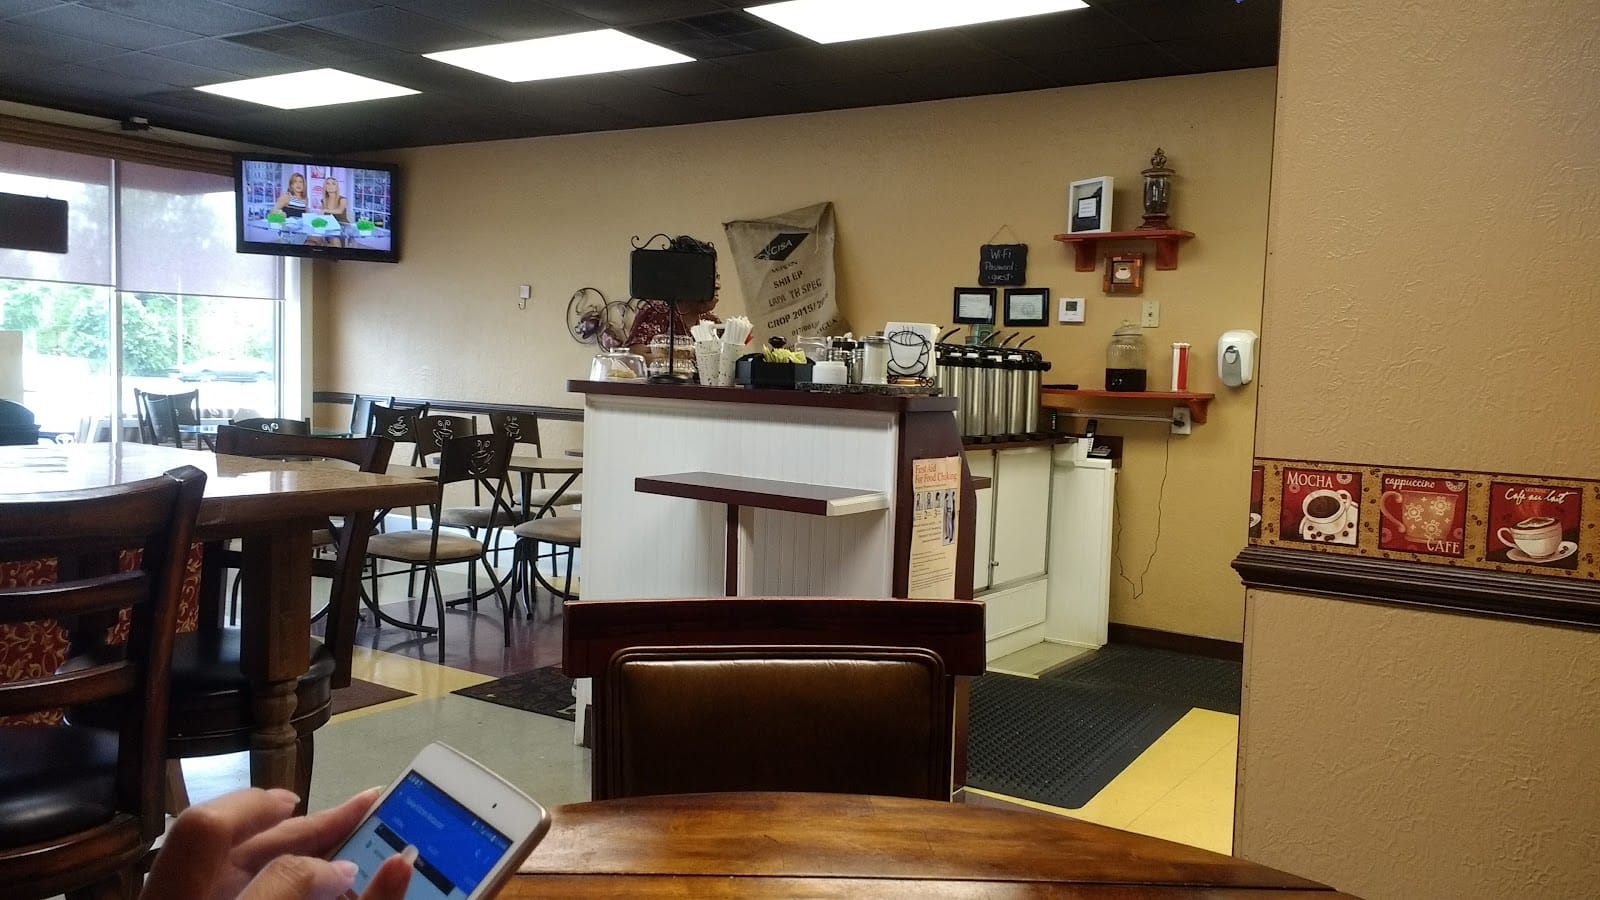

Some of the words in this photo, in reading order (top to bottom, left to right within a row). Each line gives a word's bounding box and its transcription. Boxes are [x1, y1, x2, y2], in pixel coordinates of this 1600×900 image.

[1287, 471, 1333, 488] MOCHA
[1385, 477, 1436, 490] cappuccino
[1427, 539, 1460, 555] CAFE
